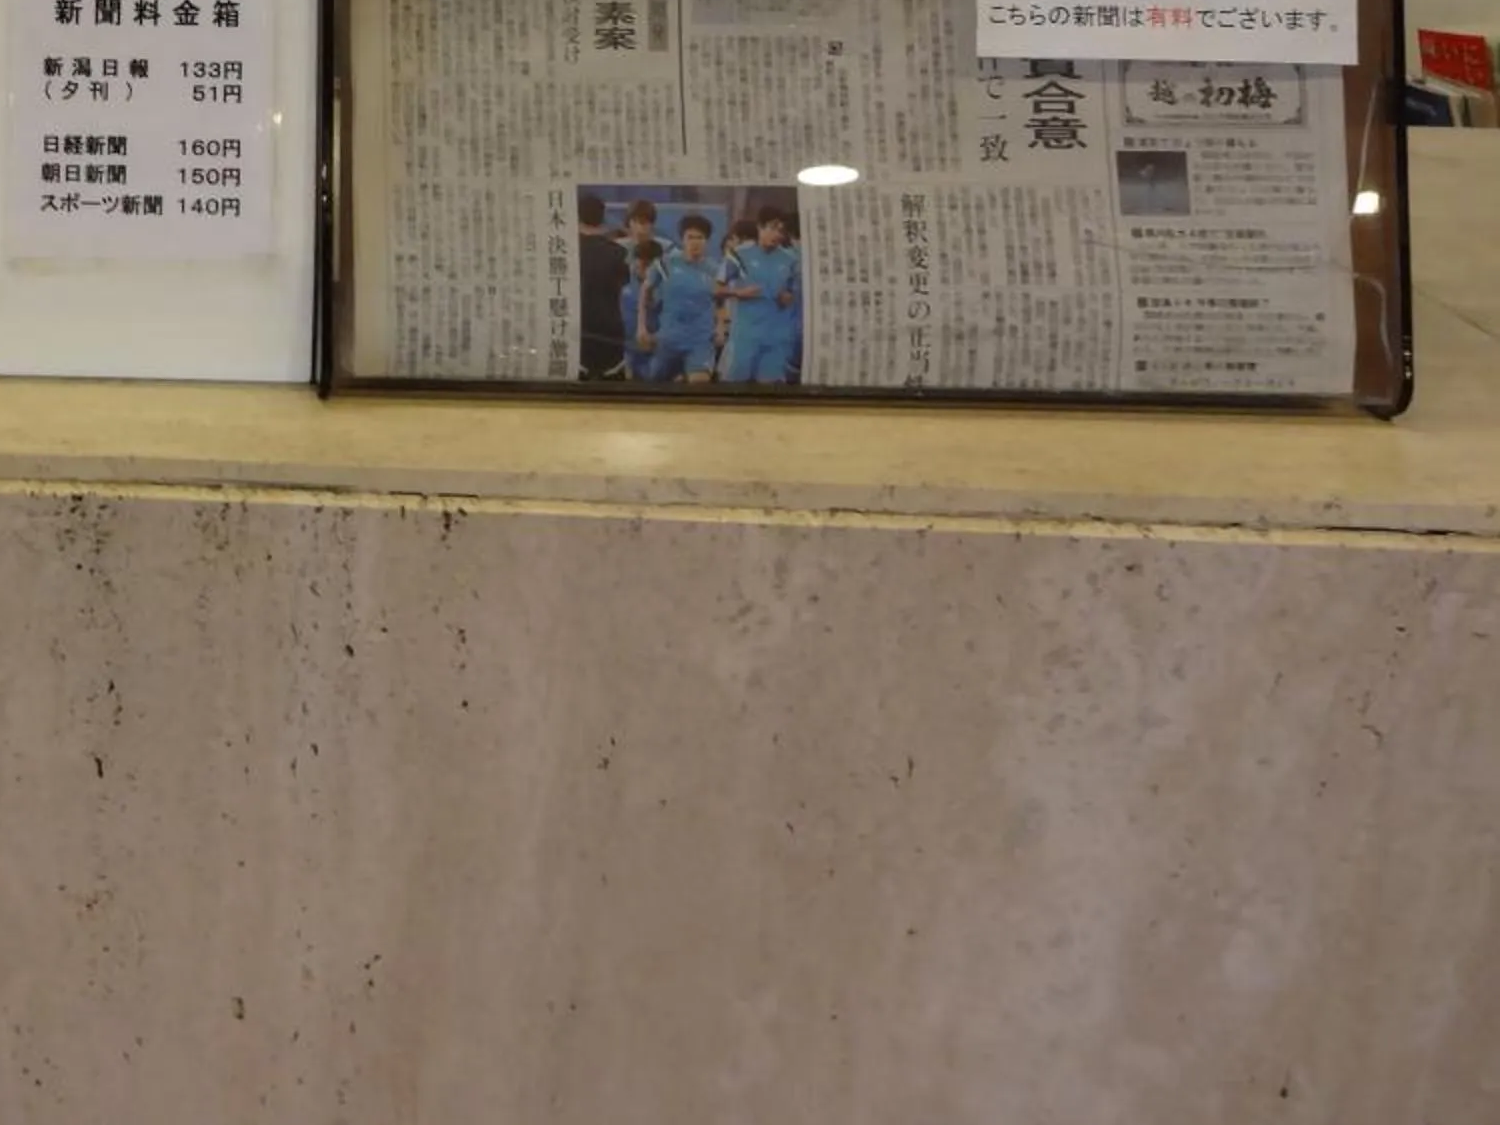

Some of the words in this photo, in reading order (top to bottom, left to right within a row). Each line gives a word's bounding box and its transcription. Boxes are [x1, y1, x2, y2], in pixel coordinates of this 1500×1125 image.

[989, 3, 1338, 34] こちらの新聞は有料でございます。
[43, 56, 149, 78] 新潟日報
[180, 61, 243, 80] 133円
[192, 84, 242, 103] 51円
[43, 135, 127, 157] 日経新聞
[178, 139, 242, 158] 160円
[41, 163, 127, 184] 朝日新聞
[178, 167, 242, 187] 150円
[40, 192, 164, 216] スポーツ新聞
[178, 197, 241, 217] 140円
